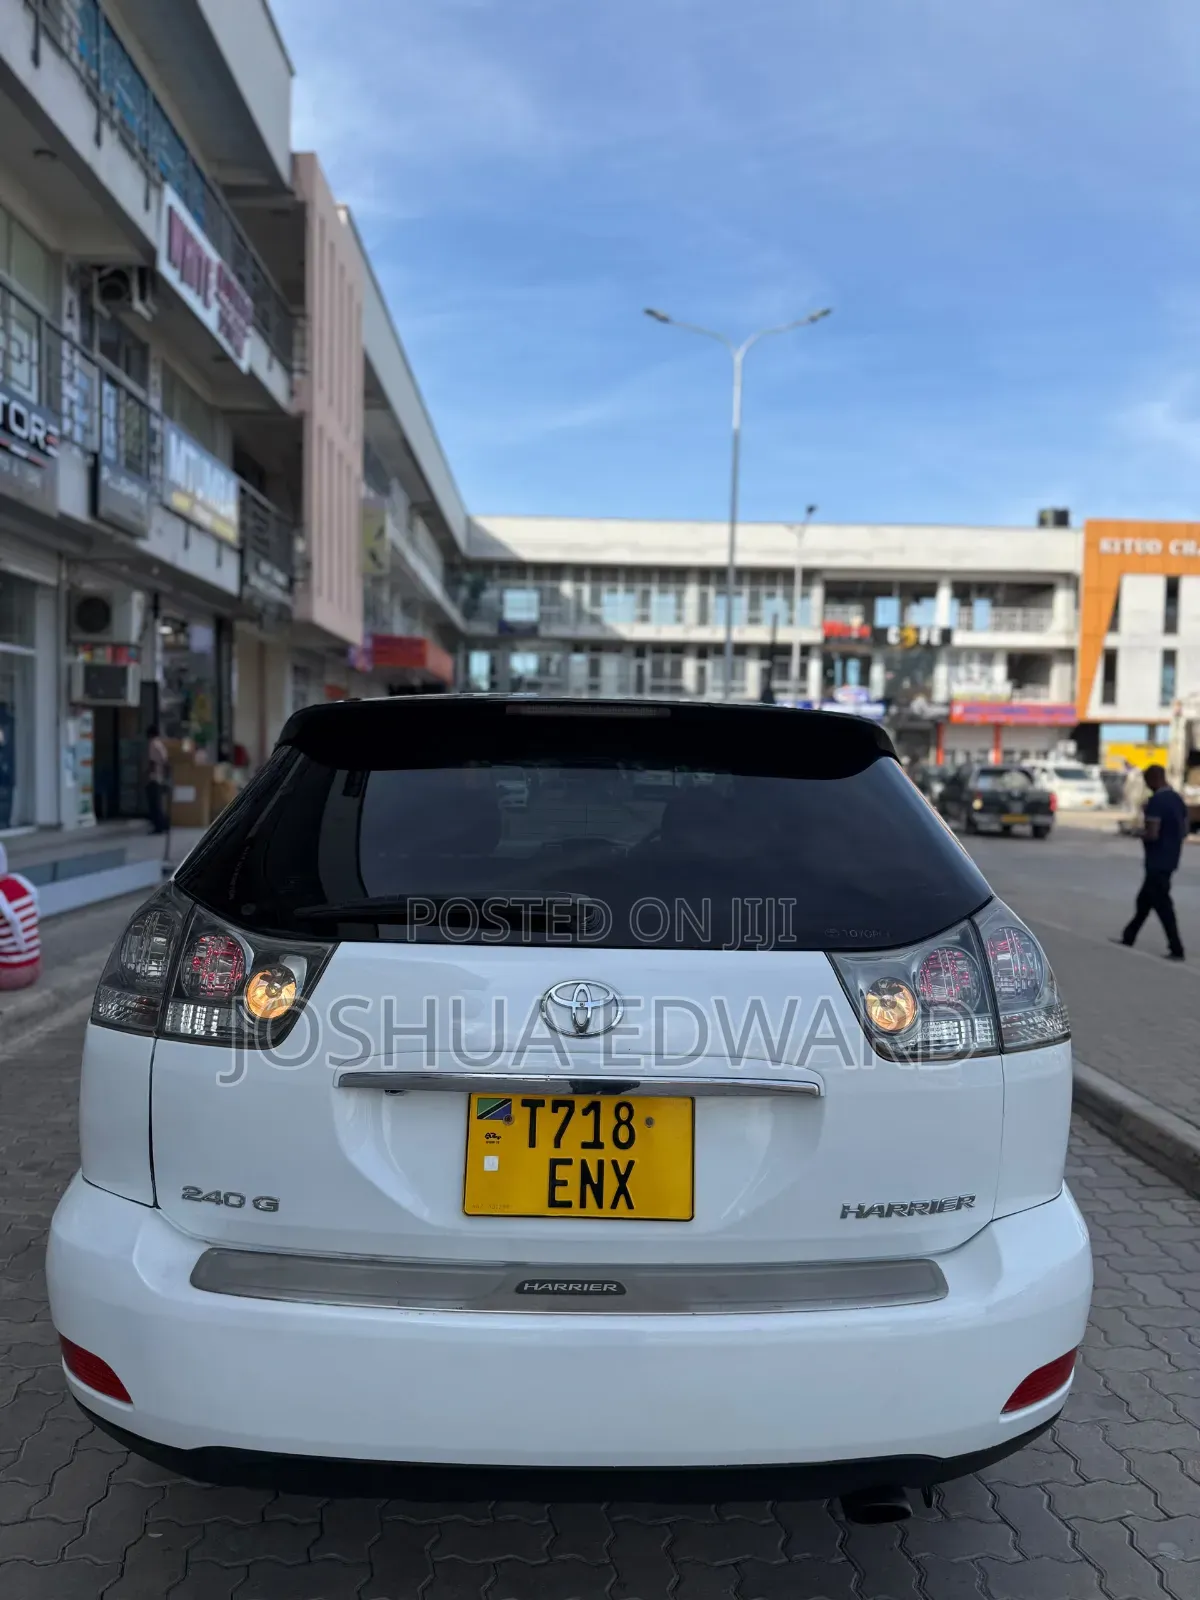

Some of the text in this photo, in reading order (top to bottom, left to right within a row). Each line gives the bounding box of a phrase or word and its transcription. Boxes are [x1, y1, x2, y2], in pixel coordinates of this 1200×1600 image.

[521, 1098, 636, 1150] T718
[548, 1158, 636, 1210] ENX
[181, 1186, 280, 1212] 240 G
[840, 1193, 976, 1219] HARRIER
[523, 1281, 618, 1292] HARRIER
